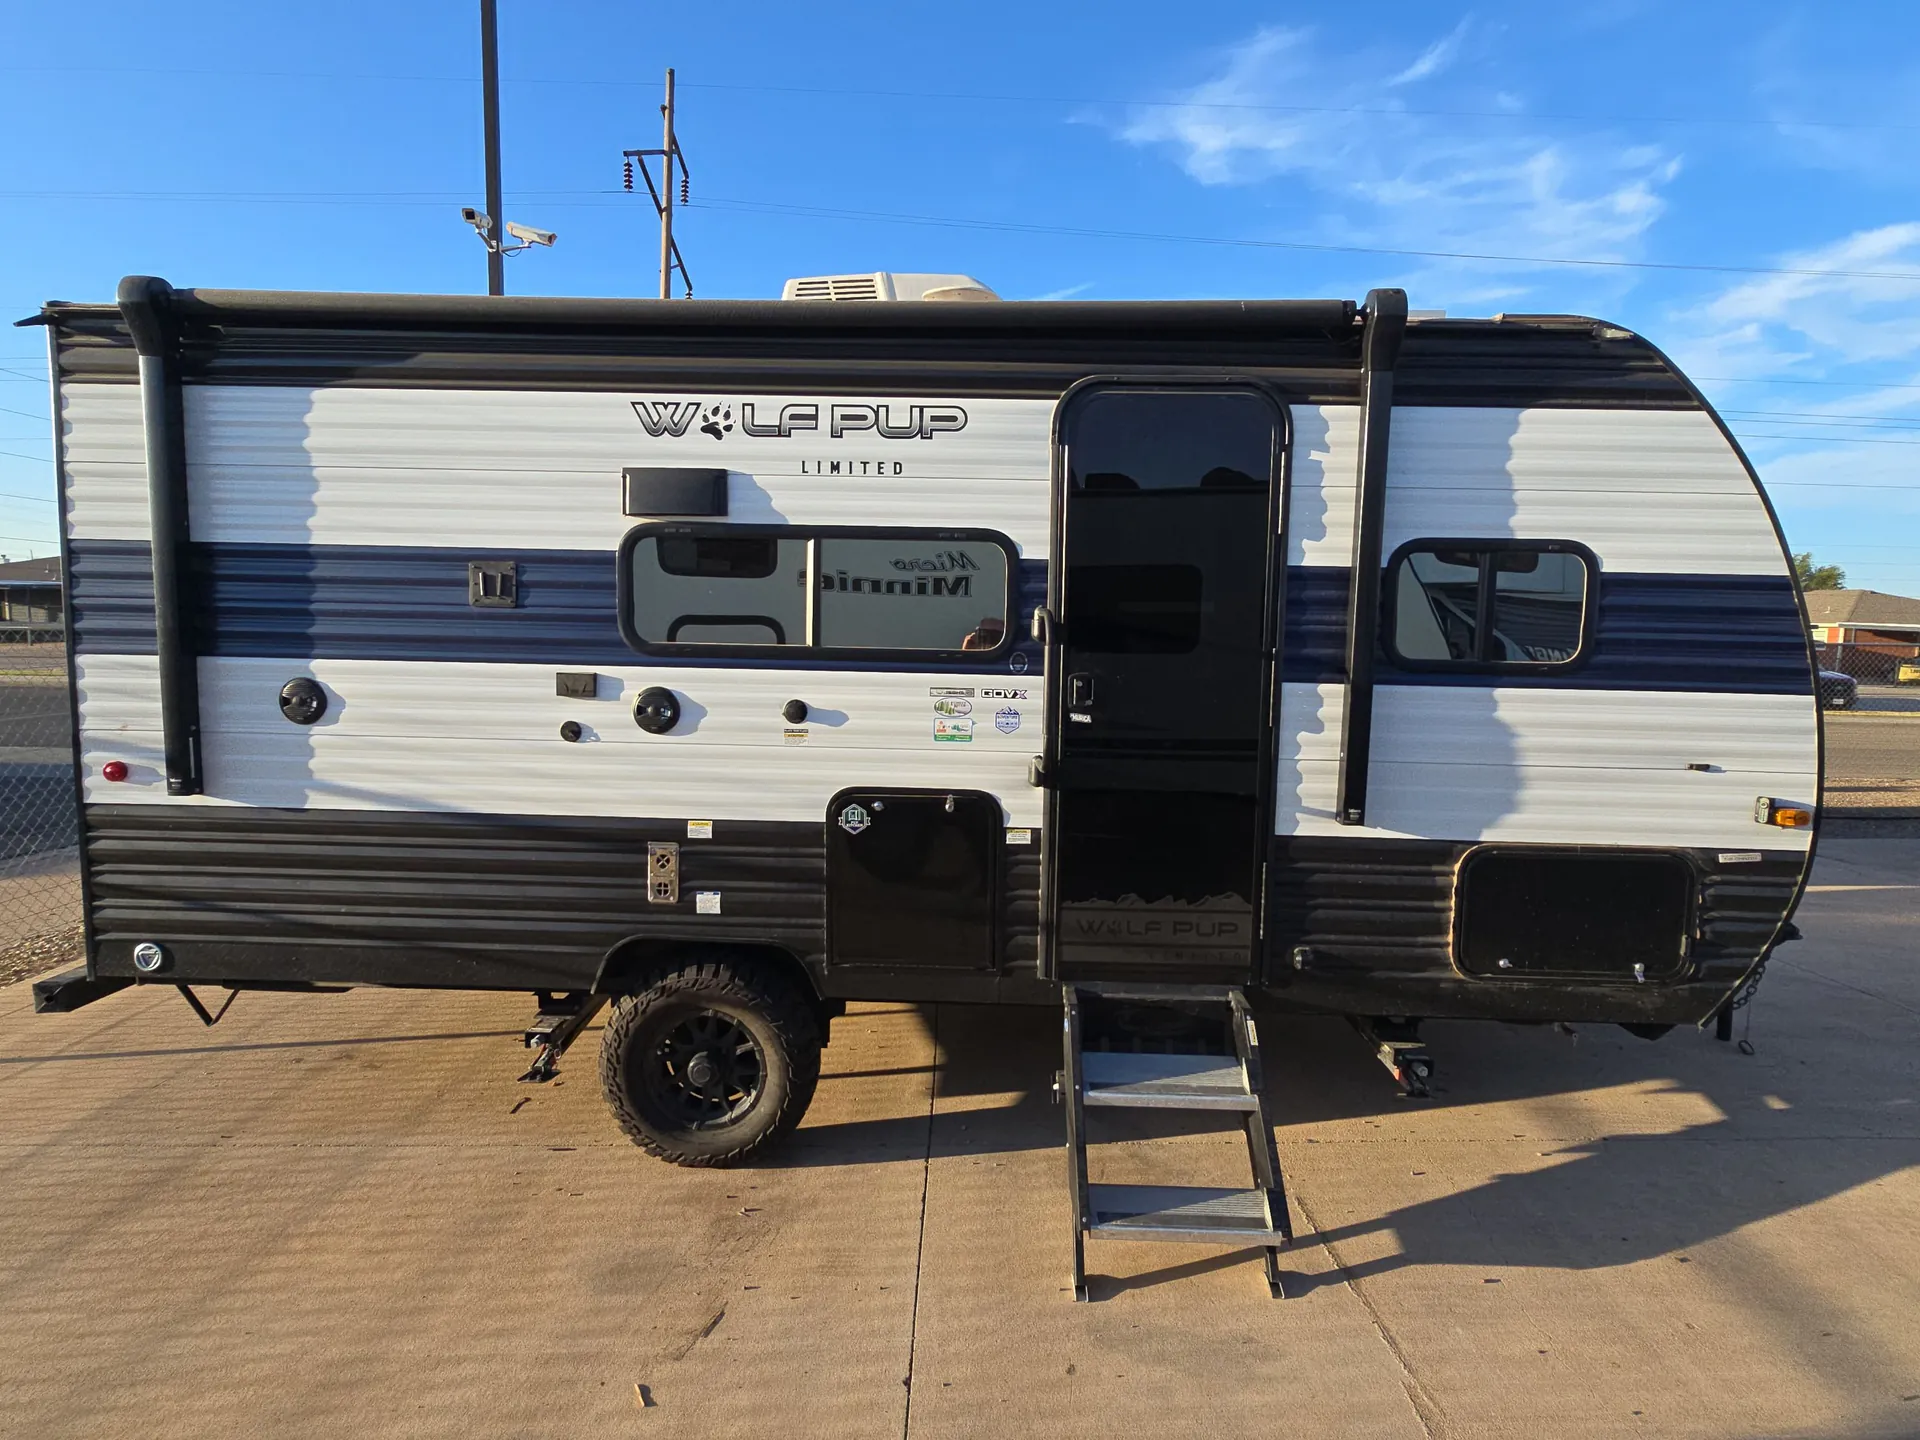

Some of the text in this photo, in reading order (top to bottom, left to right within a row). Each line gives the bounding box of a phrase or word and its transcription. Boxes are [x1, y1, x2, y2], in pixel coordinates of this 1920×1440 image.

[830, 402, 969, 440] PUP
[801, 460, 904, 475] LIMITED
[1172, 921, 1239, 938] PUP
